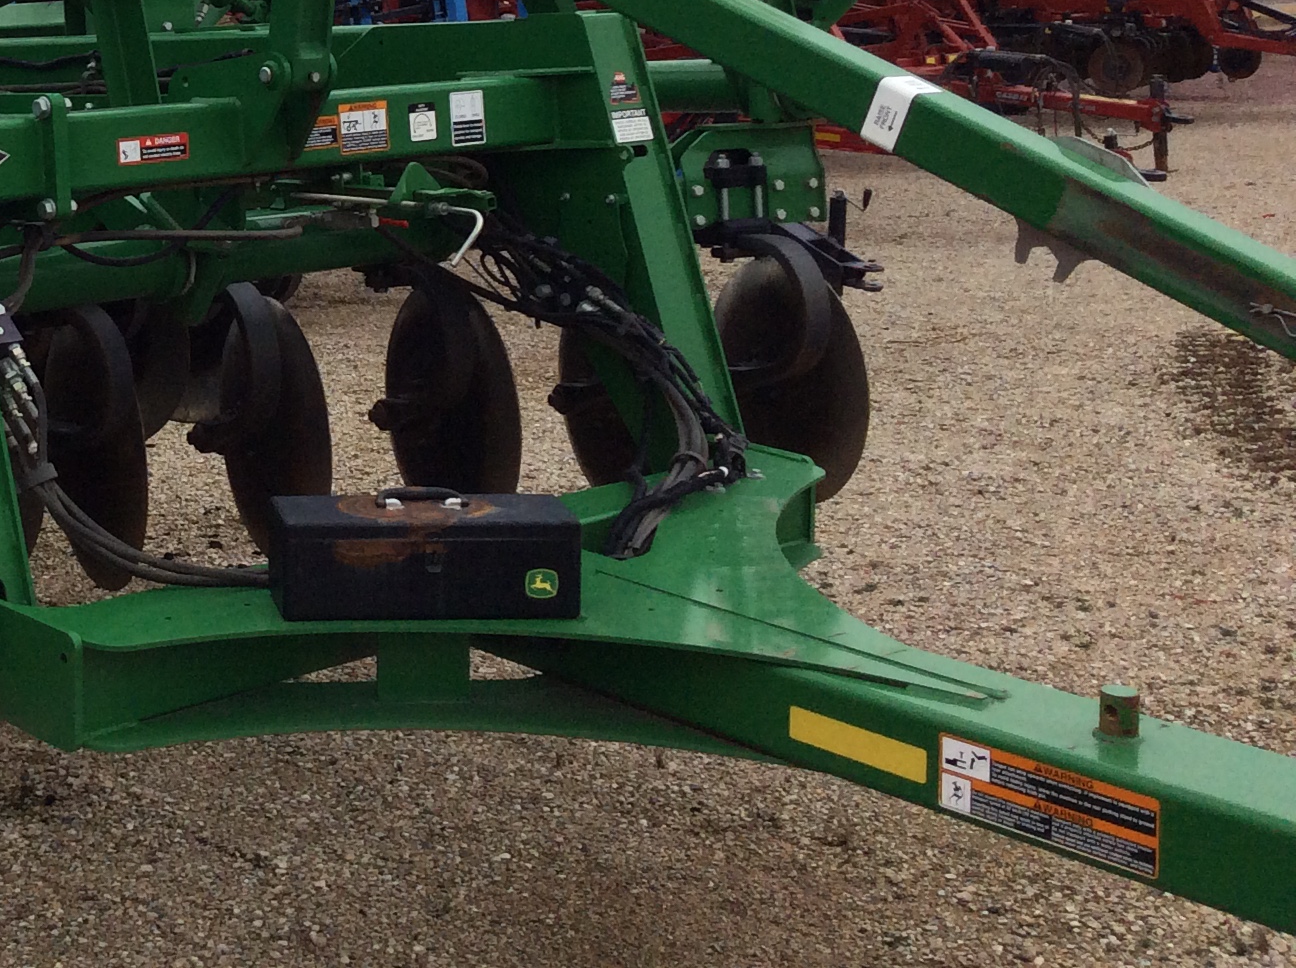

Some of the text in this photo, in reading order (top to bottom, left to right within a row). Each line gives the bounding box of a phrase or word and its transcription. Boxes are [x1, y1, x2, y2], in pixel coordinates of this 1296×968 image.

[611, 108, 646, 119] IMPORTANT
[879, 106, 892, 130] FRONT
[154, 135, 180, 145] DANGER
[1043, 766, 1094, 789] WARNING
[1043, 803, 1093, 827] WARNING
